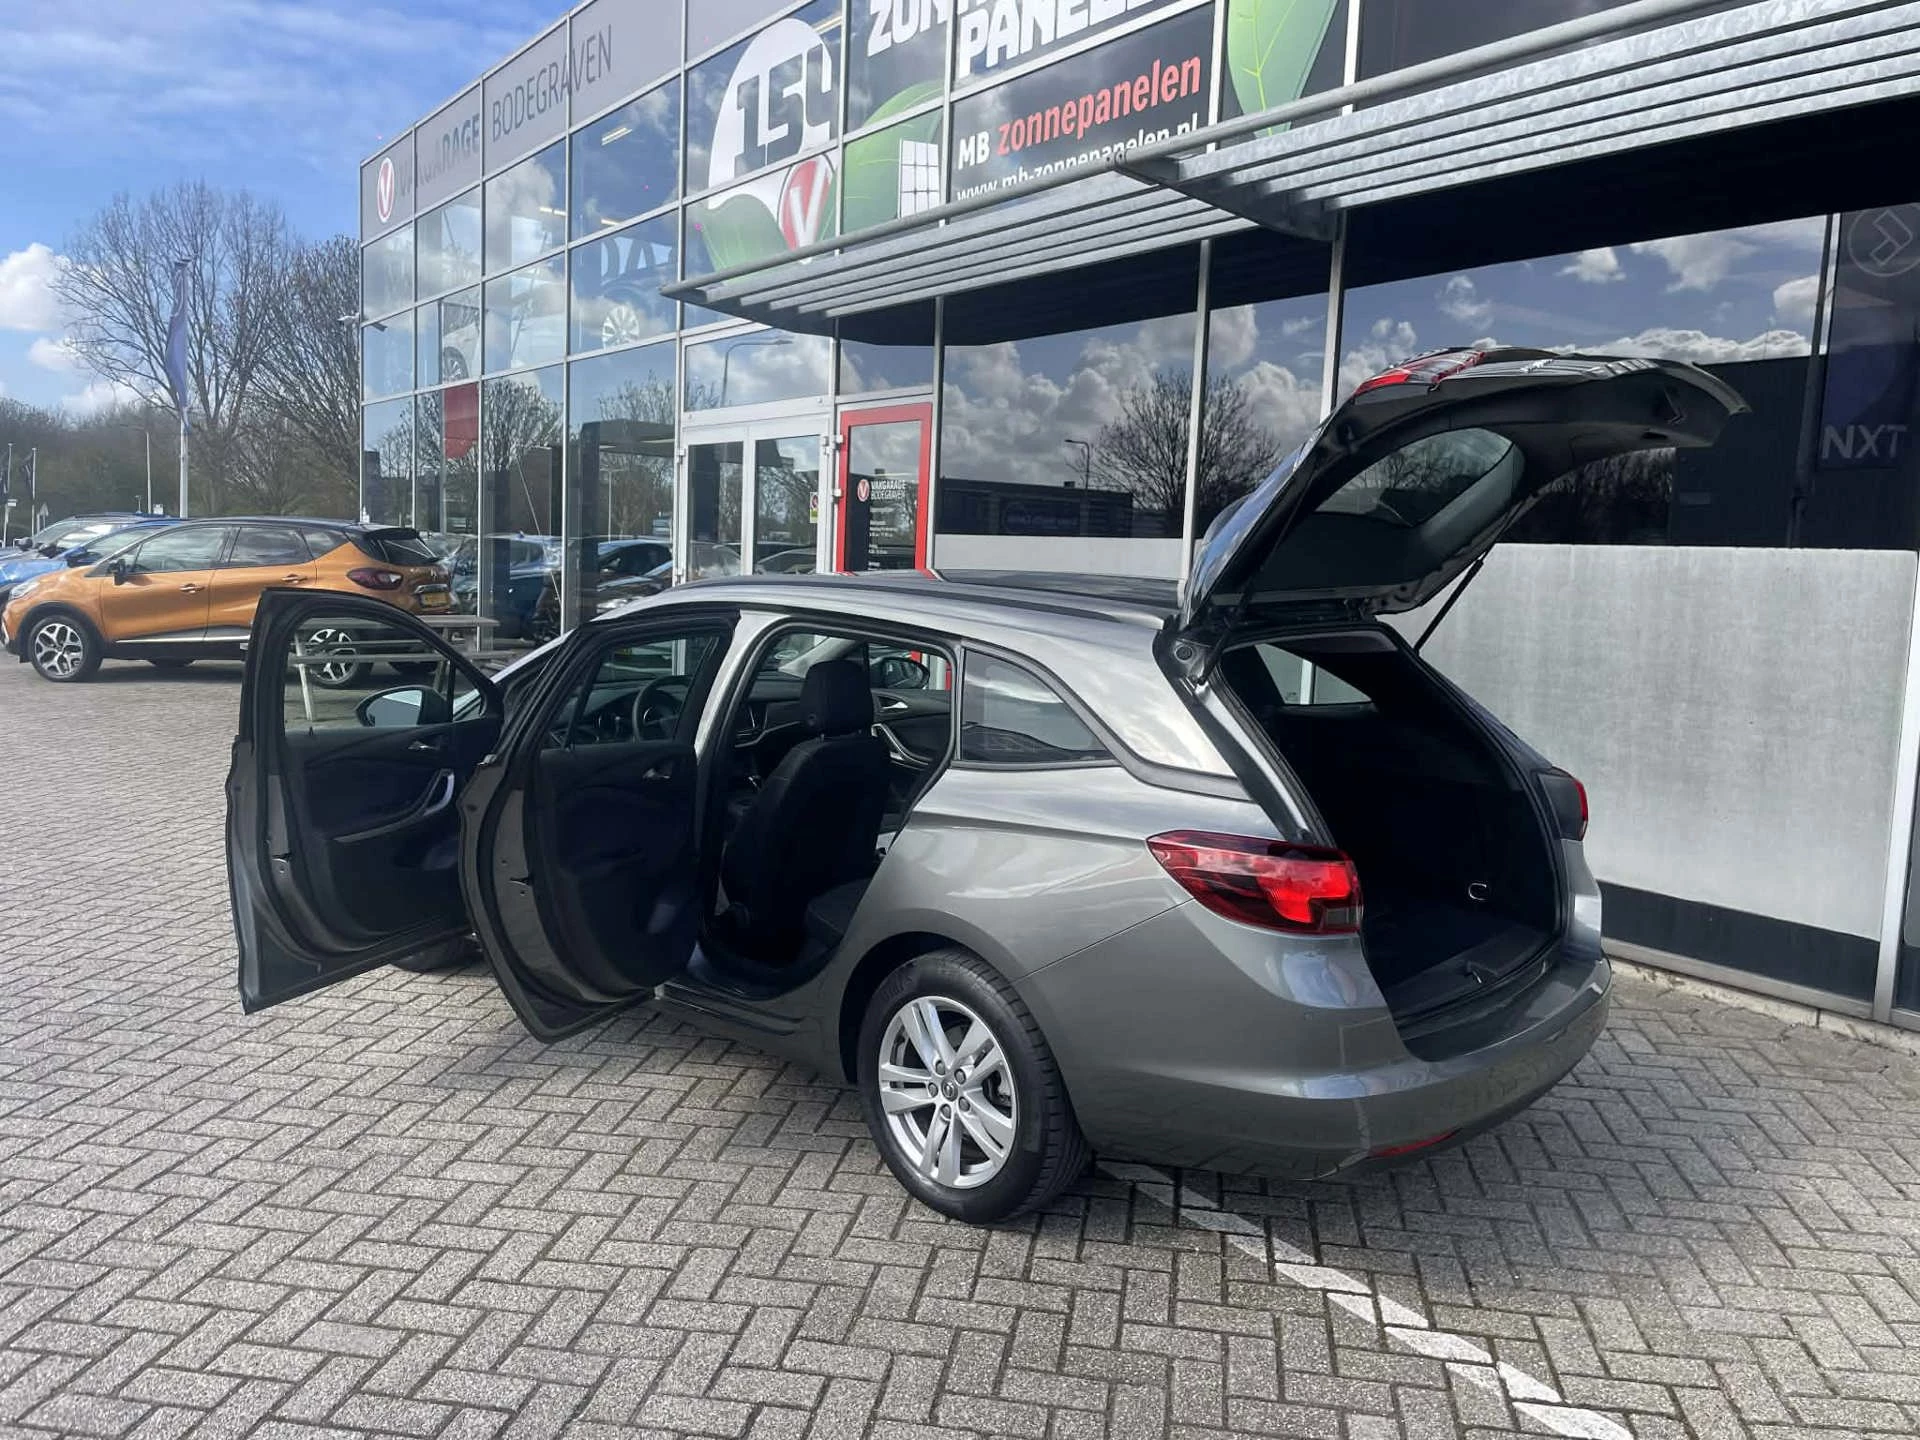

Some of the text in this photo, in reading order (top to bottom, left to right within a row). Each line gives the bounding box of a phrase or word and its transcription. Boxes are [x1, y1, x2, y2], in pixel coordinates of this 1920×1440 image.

[492, 24, 611, 141] BODEGRAVEN
[958, 0, 1151, 79] PANE
[957, 112, 1198, 201] wwwmb-zonneanelennl
[958, 55, 1200, 170] MB zonnepanelen
[1821, 424, 1908, 460] NXT
